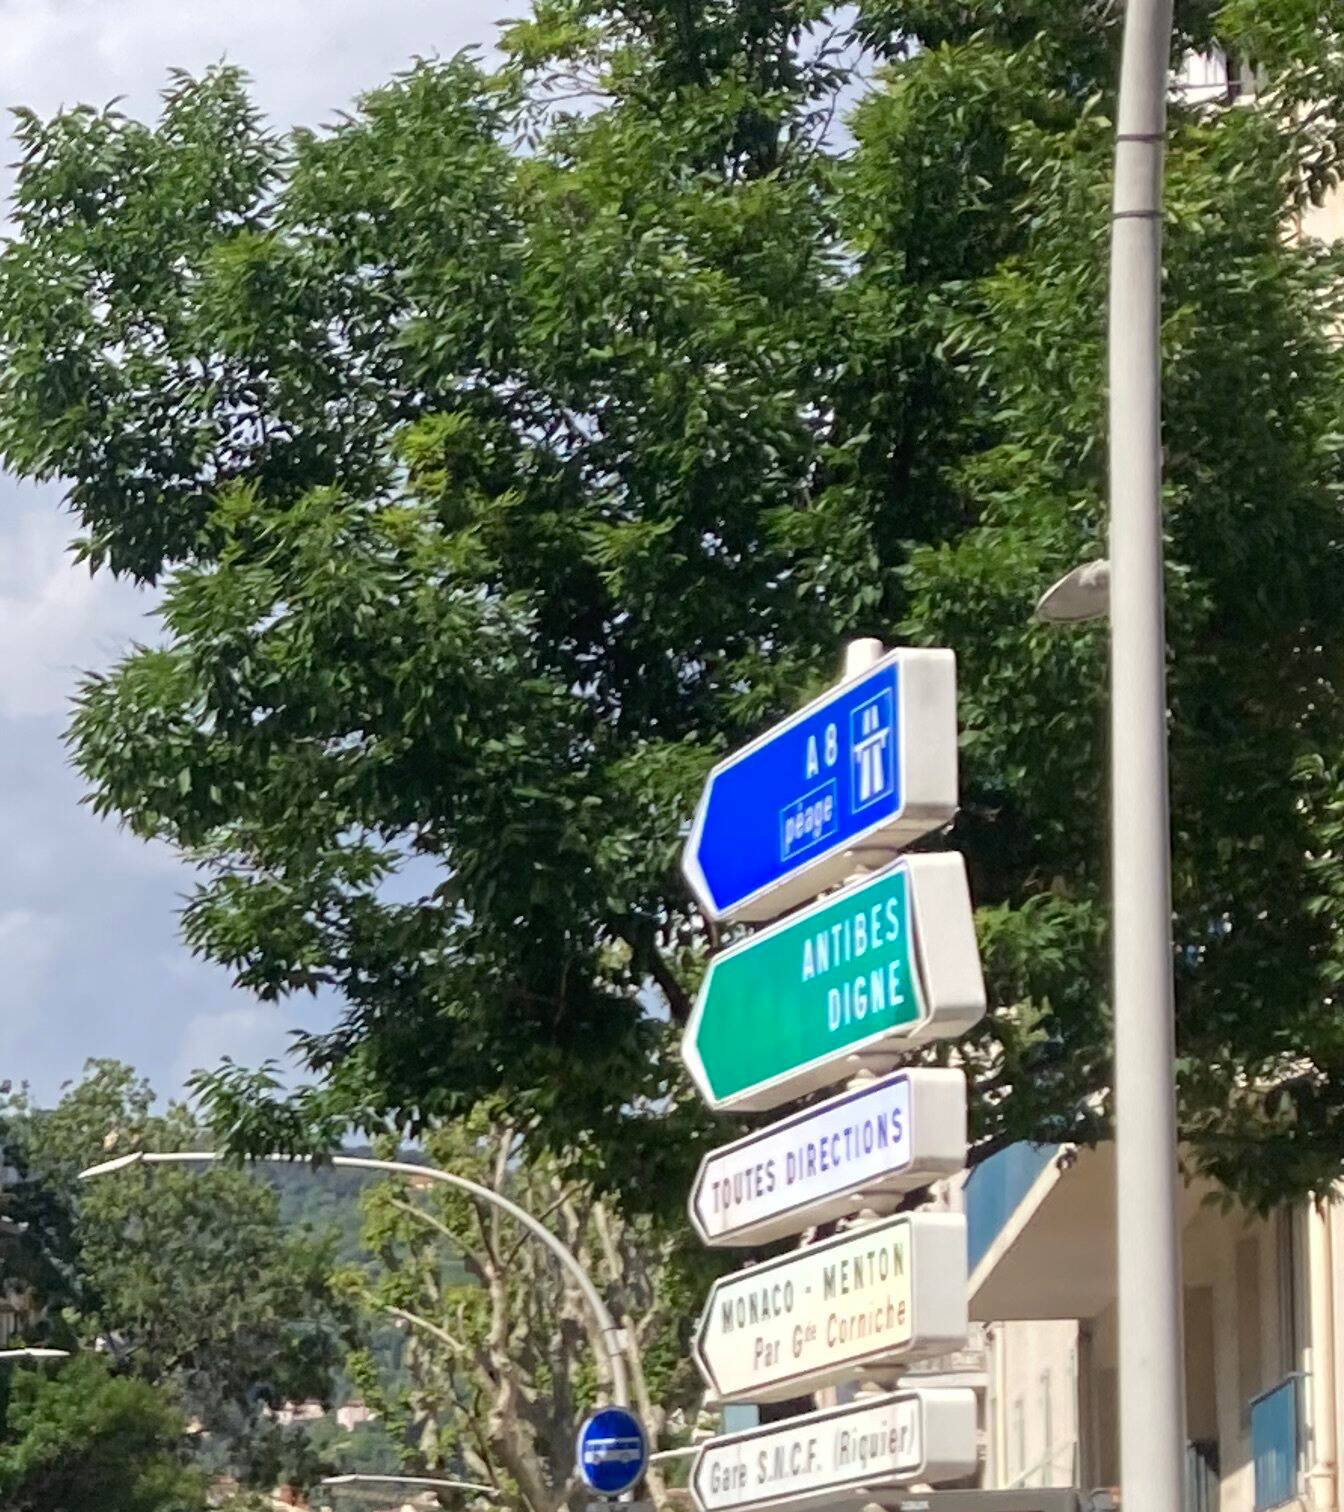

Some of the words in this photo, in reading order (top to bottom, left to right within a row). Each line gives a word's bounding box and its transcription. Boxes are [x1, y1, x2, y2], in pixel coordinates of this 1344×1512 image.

[784, 793, 834, 849] péage
[801, 897, 899, 982] ANTIBES
[827, 959, 905, 1032] DIGNE
[711, 1159, 776, 1214] TOUTES
[786, 1107, 903, 1186] DIRECTIONS
[721, 1280, 794, 1333] MONACO
[823, 1242, 904, 1301] MENTON
[753, 1336, 780, 1370] Par
[827, 1294, 906, 1348] Corniche
[711, 1461, 747, 1494] Gare
[834, 1408, 915, 1470] (Riquier)
